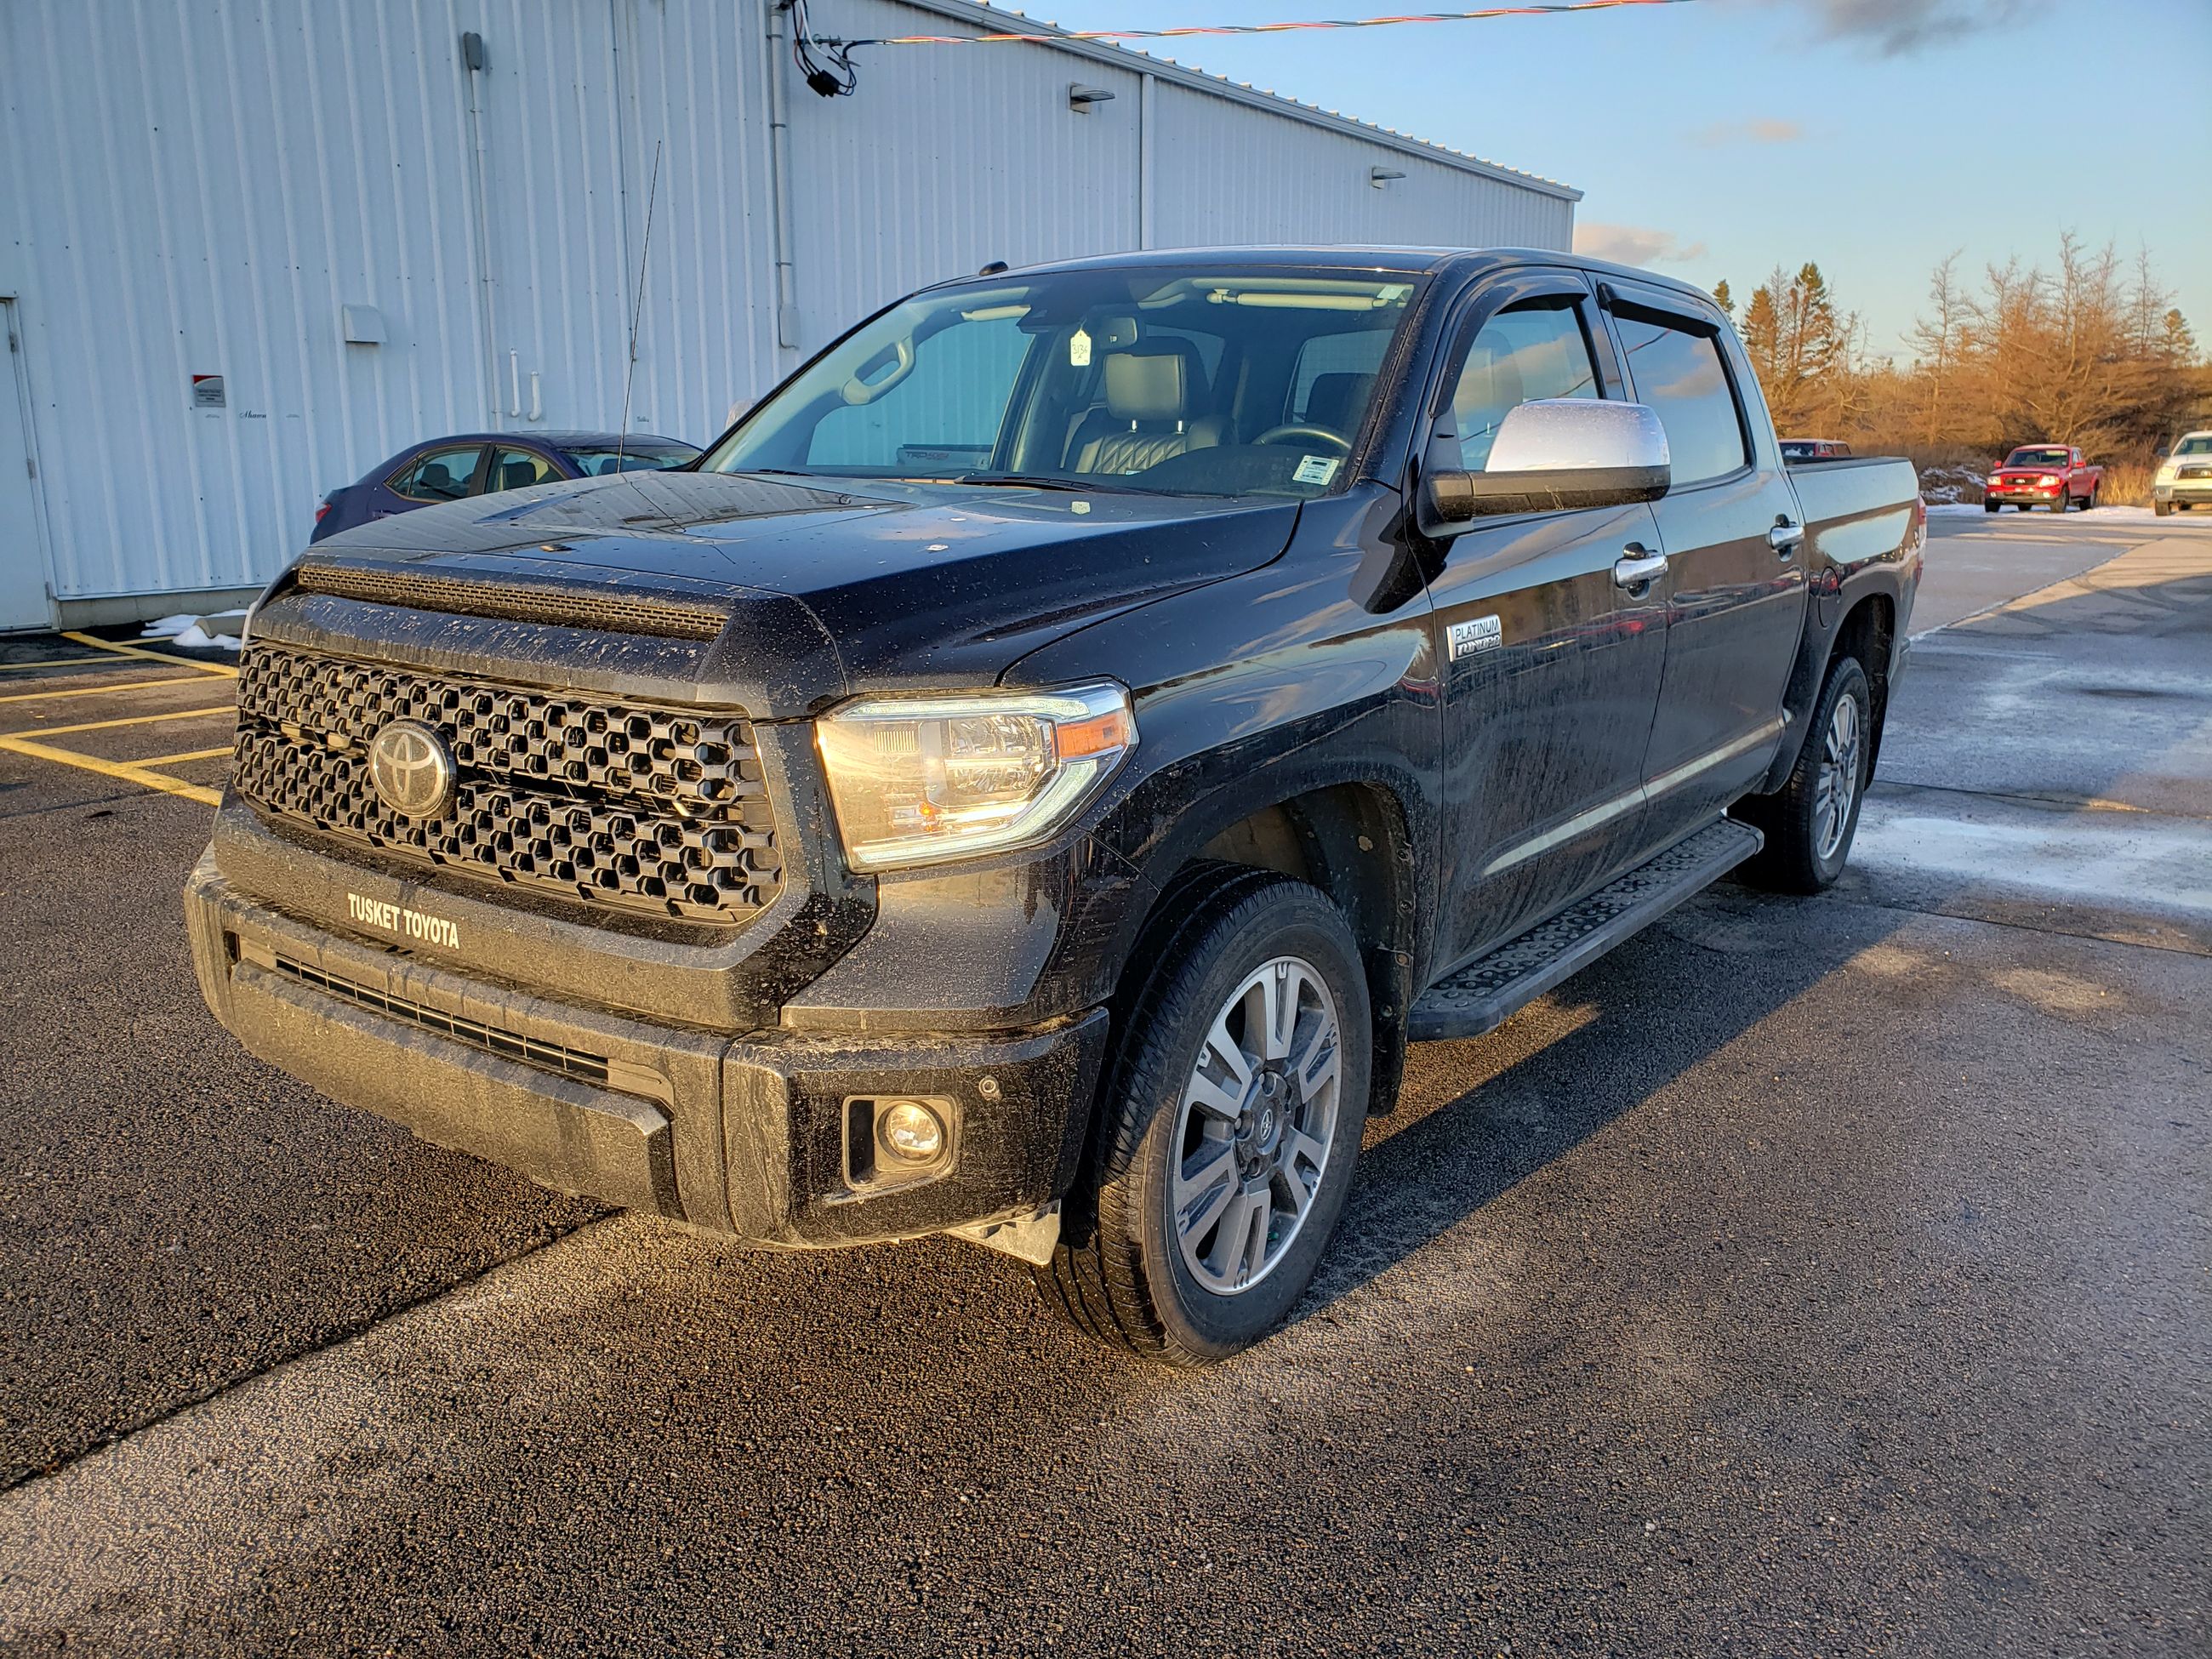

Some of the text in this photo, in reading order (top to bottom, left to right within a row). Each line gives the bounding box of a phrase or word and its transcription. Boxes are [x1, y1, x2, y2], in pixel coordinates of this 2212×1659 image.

[1455, 618, 1499, 641] PLATINUM
[347, 892, 460, 949] TUSKET TOYOTA
